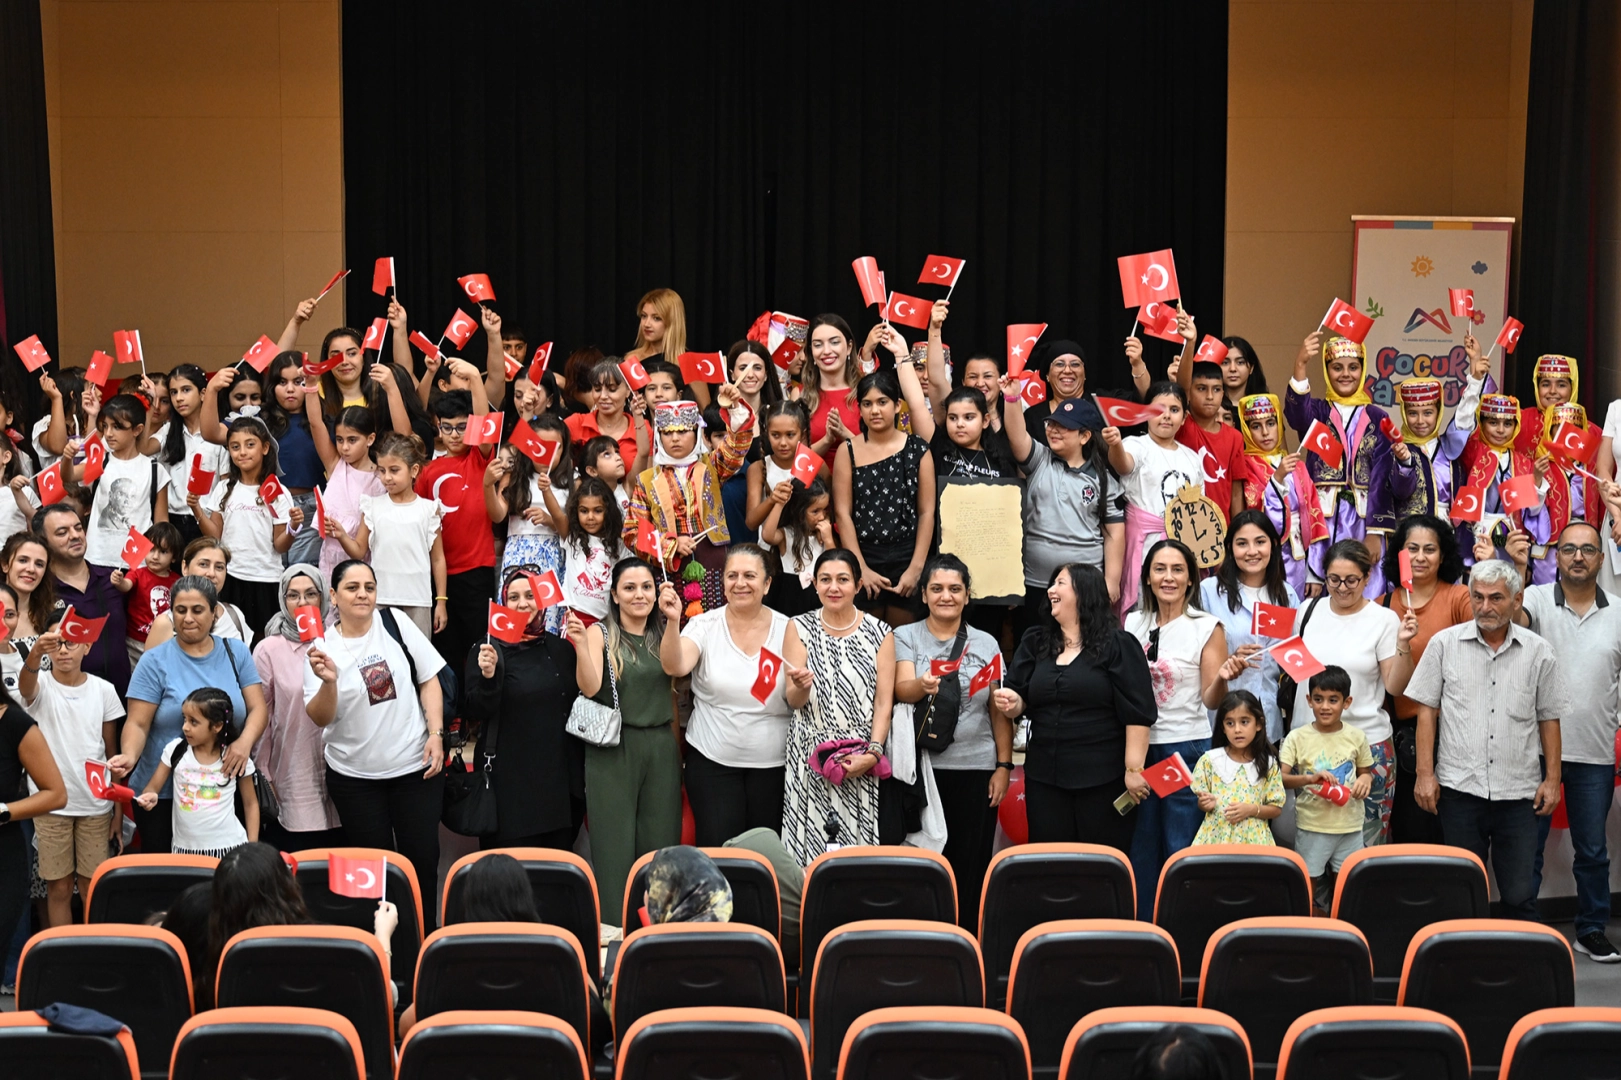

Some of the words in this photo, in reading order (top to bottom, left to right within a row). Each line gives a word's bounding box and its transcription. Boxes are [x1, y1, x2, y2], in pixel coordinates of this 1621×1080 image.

[974, 465, 1000, 478] FLEURS
[1171, 506, 1183, 519] 11
[1185, 503, 1197, 516] 12
[1200, 503, 1207, 516] 1
[1209, 511, 1217, 522] 2
[1171, 519, 1183, 531] 10
[1215, 523, 1222, 535] 3
[1174, 530, 1182, 542] 9
[1215, 536, 1223, 549] 4
[1201, 549, 1209, 564] 6
[1210, 545, 1220, 560] 5
